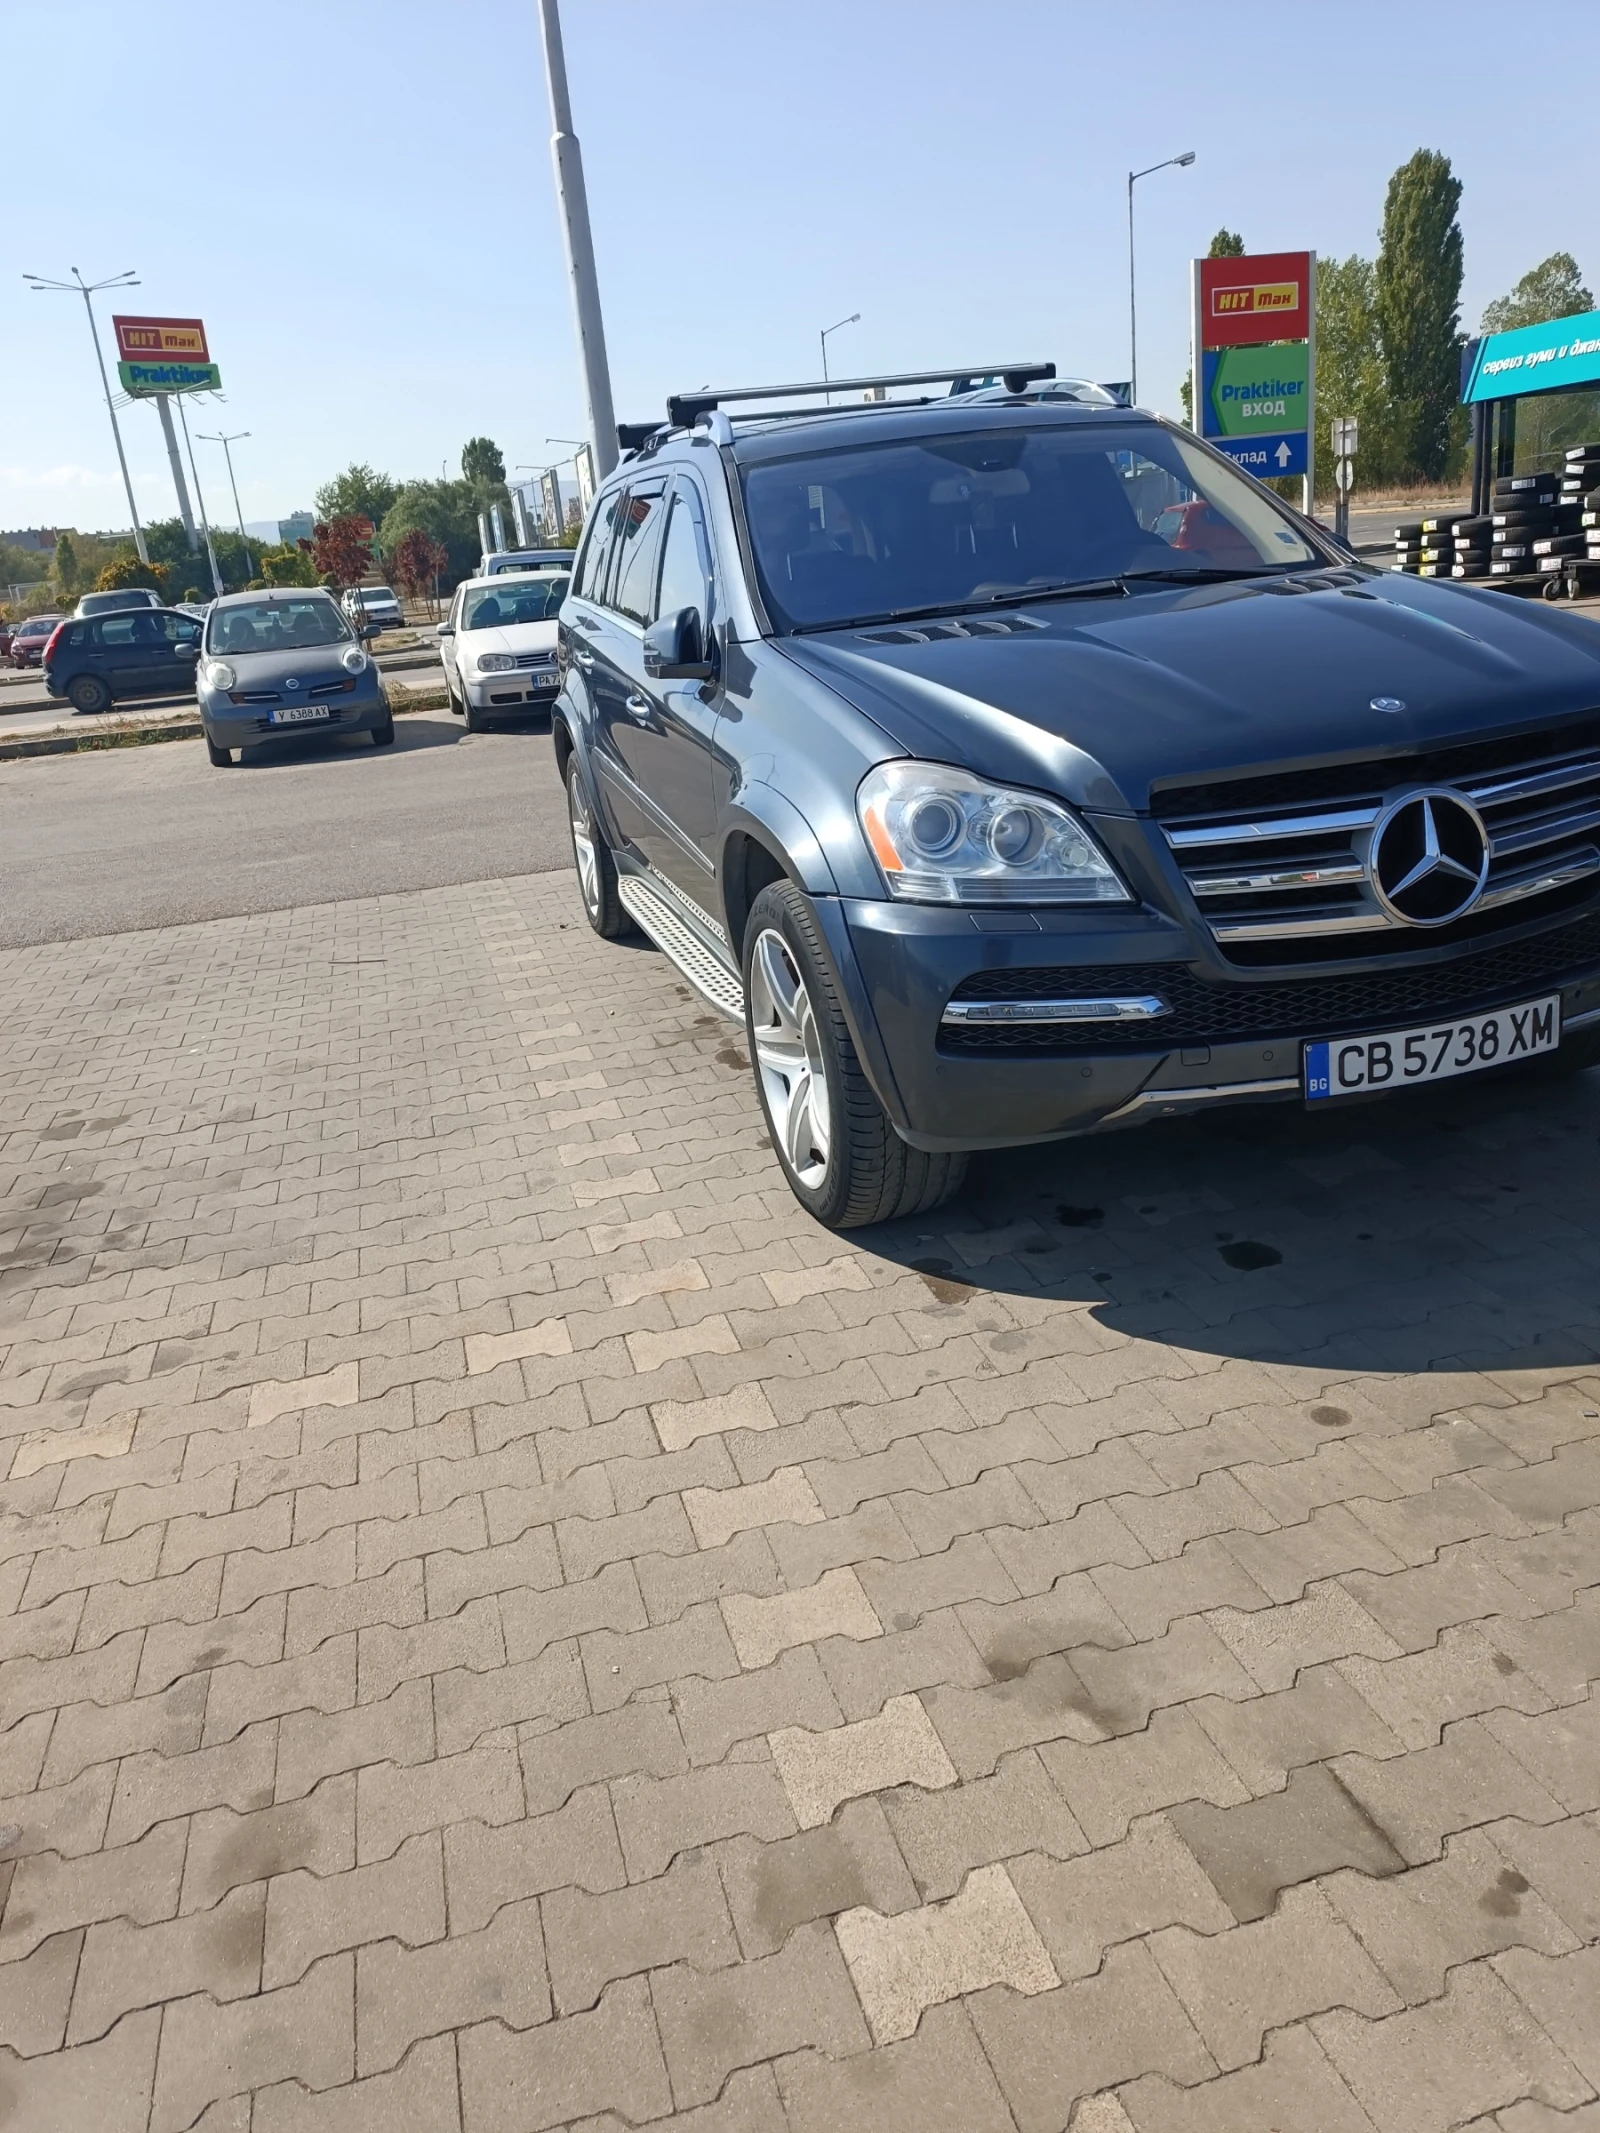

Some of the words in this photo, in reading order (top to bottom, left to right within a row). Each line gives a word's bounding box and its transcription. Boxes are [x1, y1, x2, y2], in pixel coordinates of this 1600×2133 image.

[1219, 292, 1249, 309] HIT
[128, 332, 156, 346] HIT
[1483, 355, 1524, 376] сервиз
[1525, 348, 1557, 369] гуми
[1558, 345, 1569, 358] и
[129, 364, 212, 384] Praktiker
[1221, 379, 1304, 401] Praktiker
[1242, 401, 1286, 417] ВХОД
[1338, 1041, 1394, 1088] CB
[1403, 1019, 1500, 1077] 5738
[1508, 1003, 1554, 1055] XM
[1309, 1077, 1328, 1092] BG
